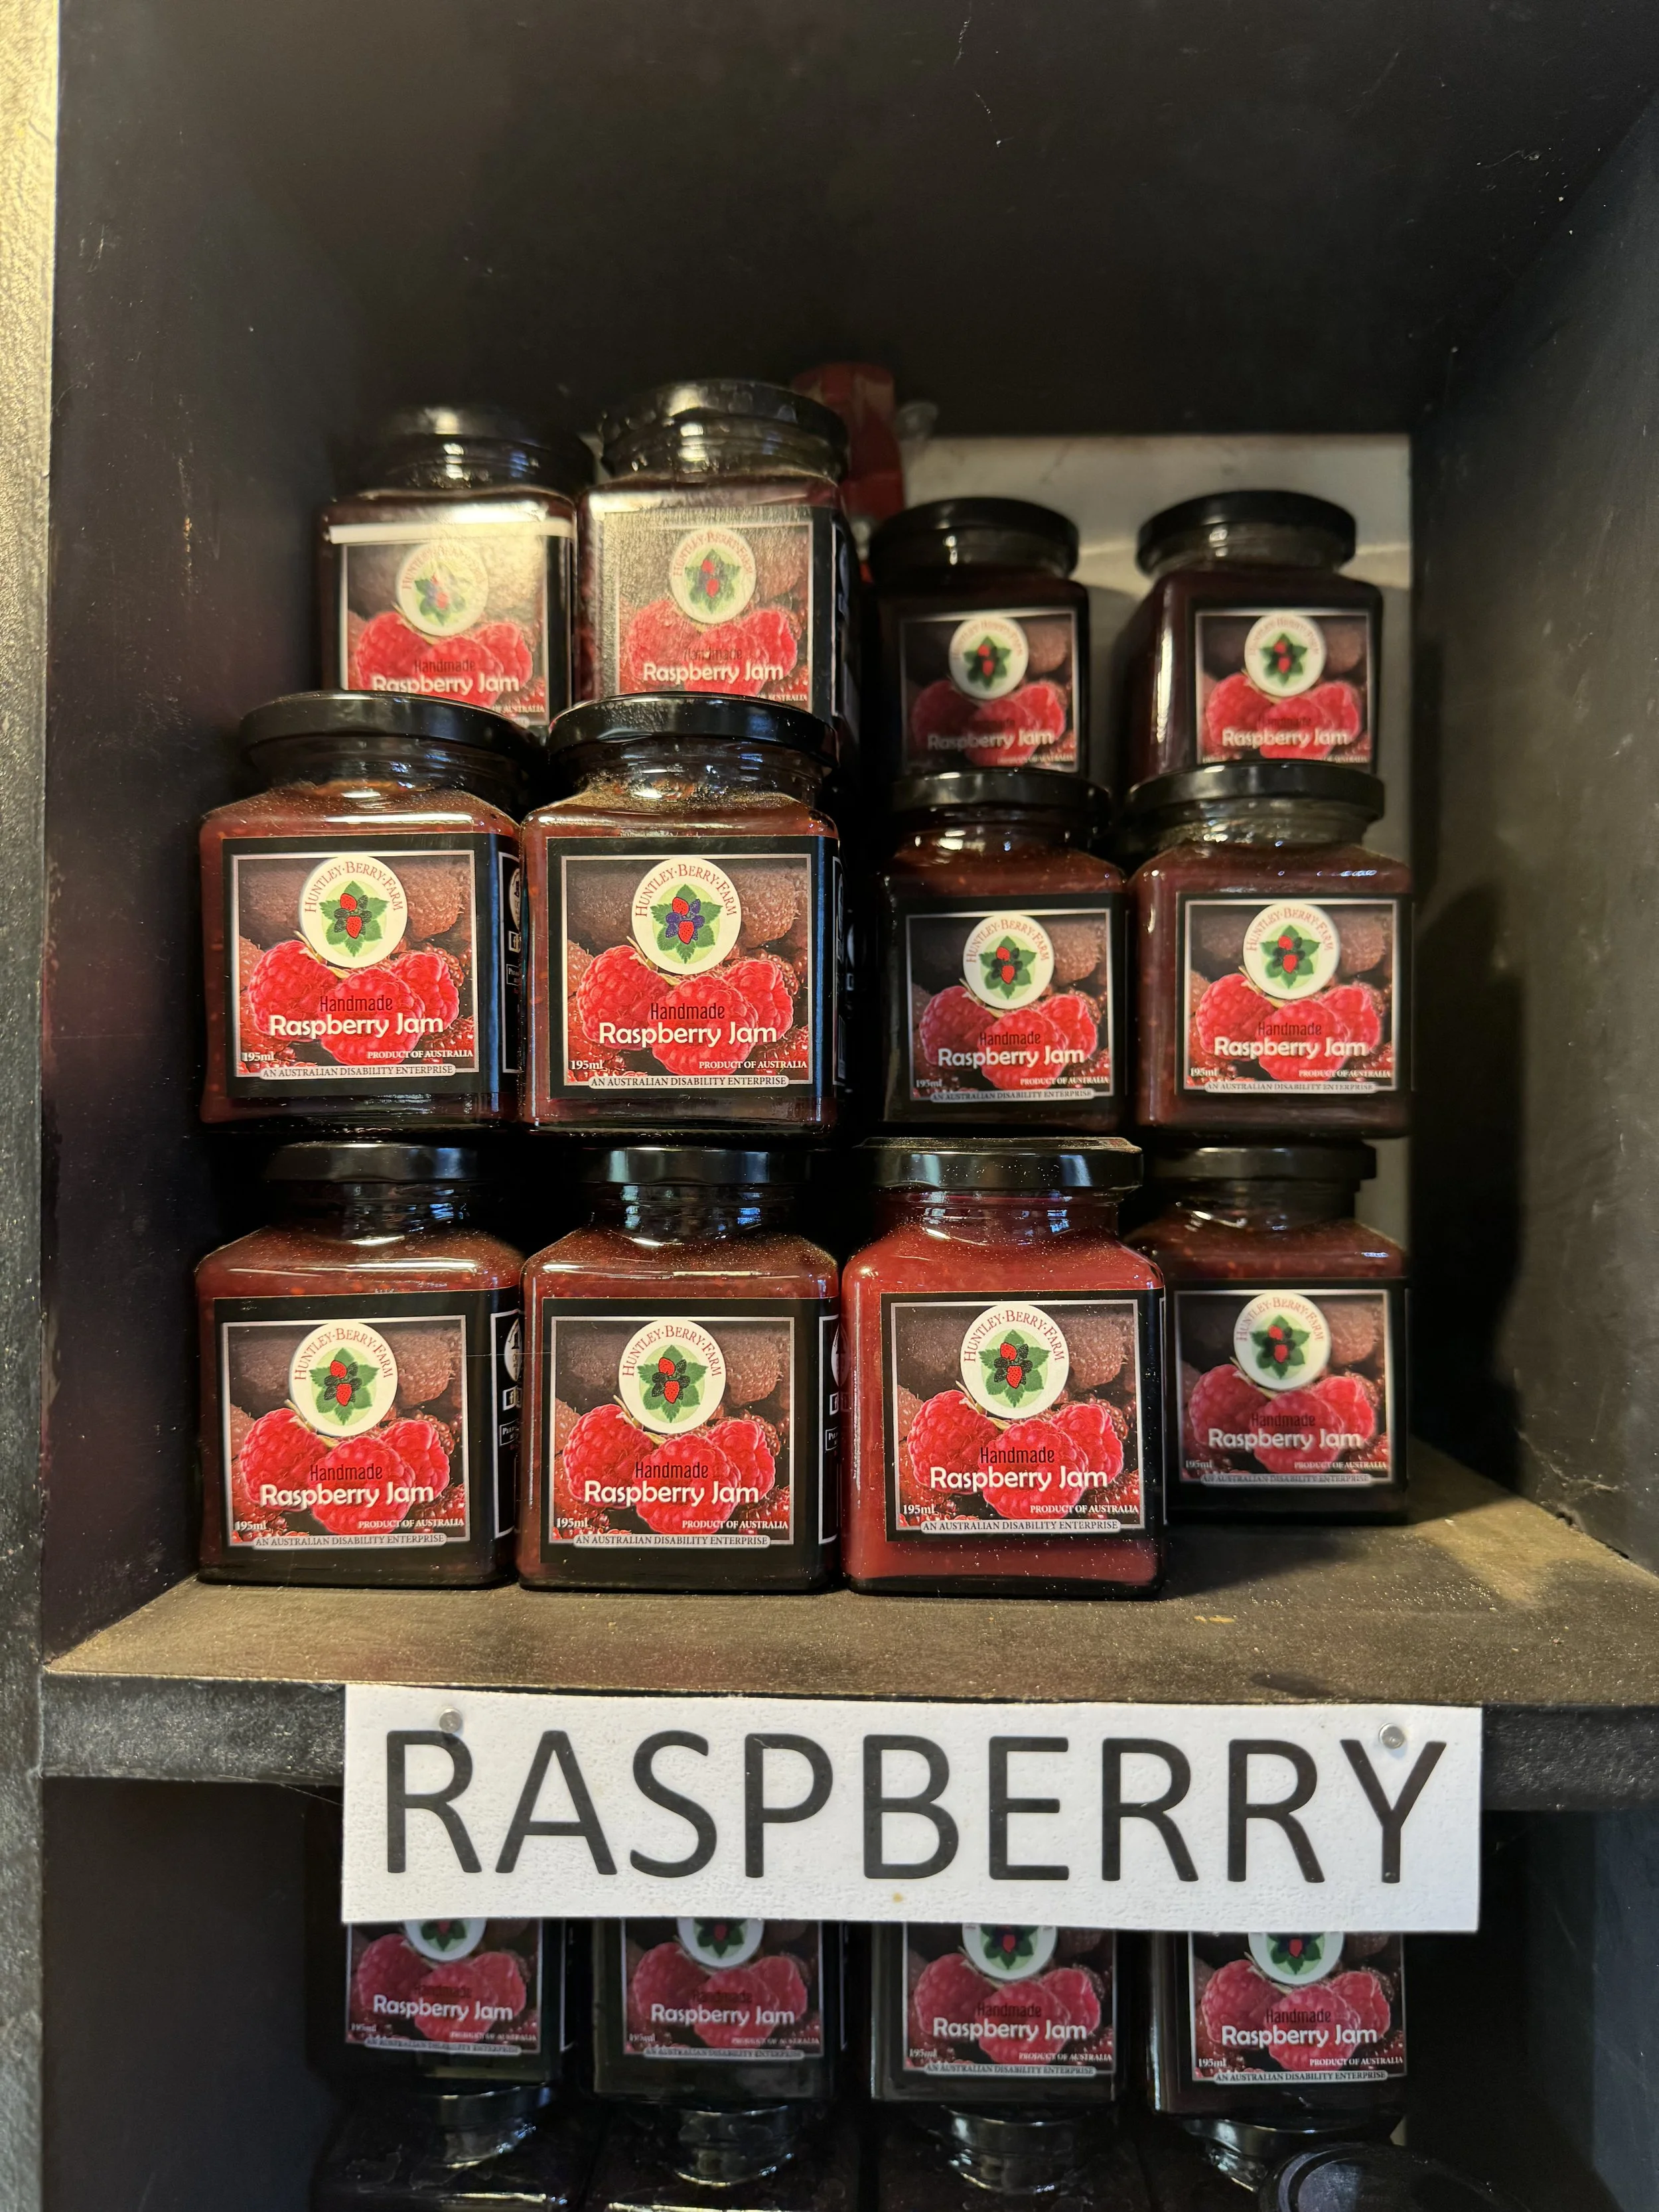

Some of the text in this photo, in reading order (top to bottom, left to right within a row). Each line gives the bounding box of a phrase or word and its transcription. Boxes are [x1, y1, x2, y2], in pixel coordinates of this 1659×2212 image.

[643, 661, 784, 684] Raspberry Jam
[372, 673, 519, 696] Raspberry Jam
[928, 729, 1015, 750] Raspberry
[1222, 727, 1347, 749] Raspberry Jam
[305, 861, 403, 912] HUNTLEY BERRY FARM
[636, 864, 737, 917] HUNTLEY BERRY FARM
[967, 919, 1049, 962] HUNTLEY BERRY FARM
[319, 994, 392, 1011] Handmade
[650, 1002, 725, 1019] Handmade
[270, 1012, 443, 1039] Raspberry Jam
[599, 1021, 777, 1047] Raspberry Jam
[979, 1031, 1041, 1045] Handmade
[1214, 1037, 1366, 1059] Raspberry Jam
[244, 1053, 274, 1062] 195ml
[571, 1061, 603, 1070] 195ml
[938, 1045, 1084, 1069] Raspberry Jam
[279, 1068, 337, 1077] AUSTRALIAN
[340, 1067, 394, 1075] DISABILITY
[964, 1310, 1064, 1361] HUNTLEY BERRY FARM
[295, 1328, 393, 1380] HUNTLEY BERRY FARM
[623, 1325, 721, 1376] HUNTLEY BERRY FARM
[1252, 1412, 1315, 1427] Handmade
[1208, 1428, 1360, 1450] Raspberry Jam
[980, 1447, 1054, 1463] Handmade
[311, 1463, 383, 1481] Handmade
[634, 1461, 709, 1479] Handmade
[930, 1465, 1108, 1491] Raspberry Jam
[262, 1481, 434, 1509] Raspberry Jam
[584, 1479, 759, 1507] Raspberry Jam
[903, 1505, 934, 1514] 195ml
[236, 1521, 266, 1530] 195ml
[557, 1518, 588, 1528] 195ml
[739, 1520, 788, 1529] AUSTRALIA
[271, 1537, 328, 1546] AUSTRALIAN
[387, 1730, 1447, 1883] RASPBERRY
[373, 1994, 513, 2022] Raspberry Jam
[651, 2003, 794, 2027] Raspberry Jam
[1266, 2008, 1331, 2023] Handmade
[933, 2017, 1086, 2041] Raspberry Jam
[1222, 2024, 1376, 2048] Raspberry Jam
